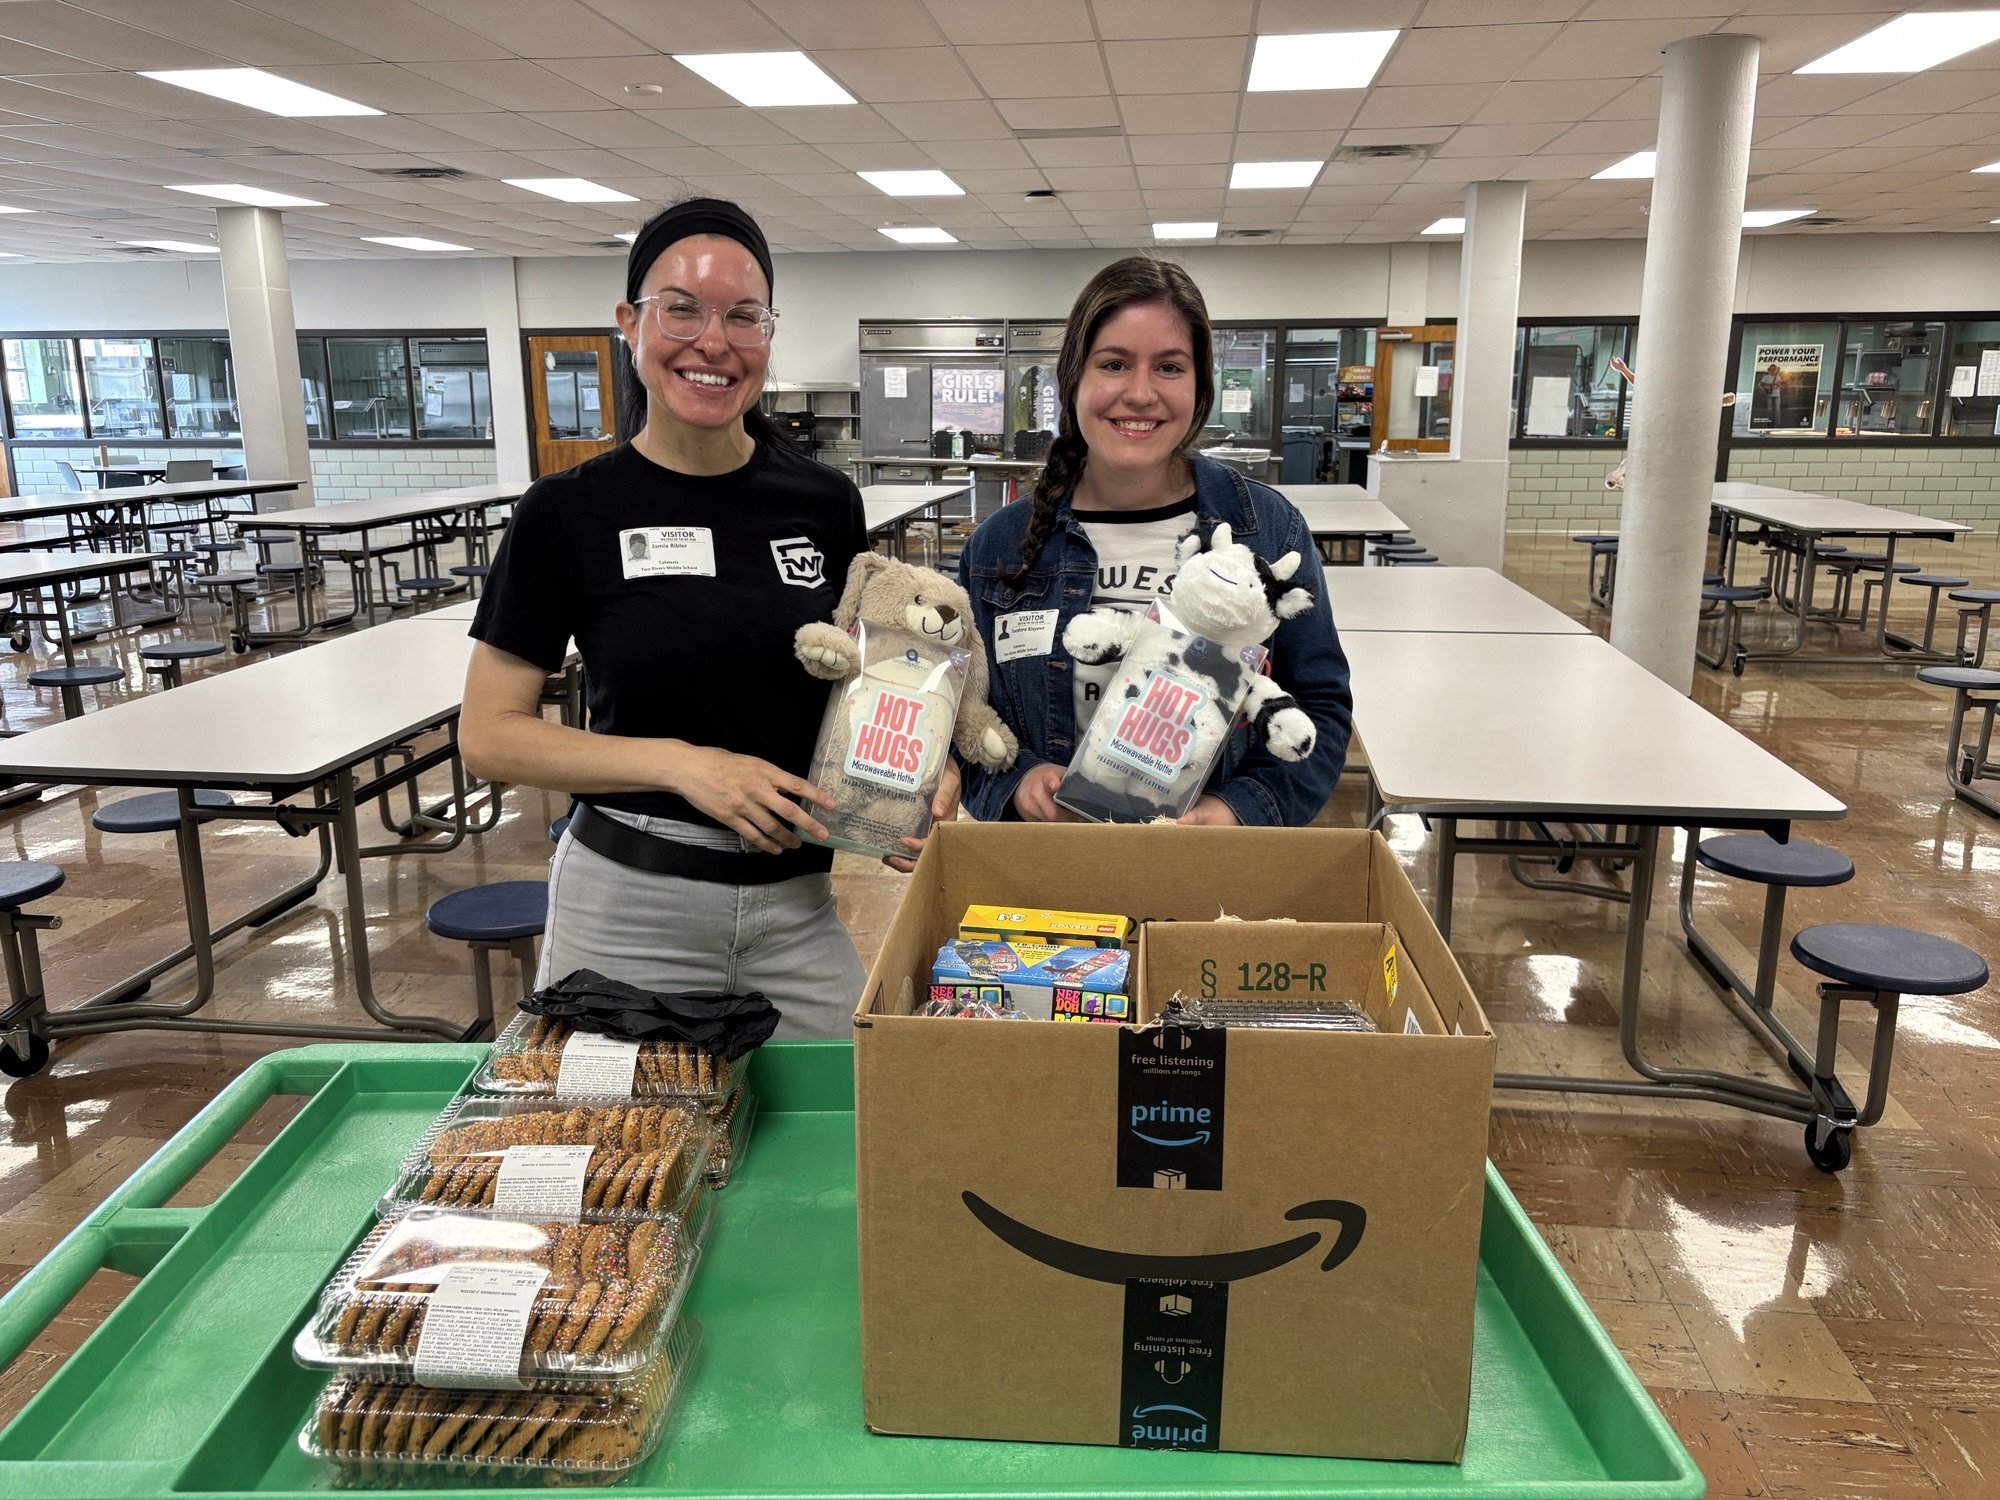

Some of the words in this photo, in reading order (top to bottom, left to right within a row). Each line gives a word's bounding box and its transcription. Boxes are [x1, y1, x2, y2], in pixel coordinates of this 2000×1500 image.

[942, 374, 994, 389] GIRLS
[942, 389, 994, 404] RULE!
[1042, 385, 1054, 432] GIRLS
[1143, 676, 1200, 726] HOT
[874, 692, 924, 736] HOT
[1116, 705, 1190, 764] HUGS
[854, 724, 924, 774] HUGS
[1110, 738, 1154, 767] Microwaveable
[1154, 756, 1173, 776] Hottie
[852, 760, 897, 779] Microwaveable
[897, 770, 915, 785] Hottie
[1096, 754, 1128, 774] FRAGRANCED
[1145, 776, 1171, 795] LAVENDER
[1238, 962, 1326, 992] 128-R
[930, 986, 954, 999] NEE
[1056, 988, 1080, 1000] NEE
[1056, 998, 1079, 1013] DOH
[1131, 1054, 1156, 1064] free
[1160, 1055, 1214, 1069] listening
[1132, 1100, 1211, 1126] prime
[1139, 1278, 1188, 1287] delivery
[1190, 1280, 1214, 1288] free
[1134, 1342, 1185, 1356] listening
[1189, 1348, 1212, 1358] free
[1131, 1424, 1207, 1446] prime
